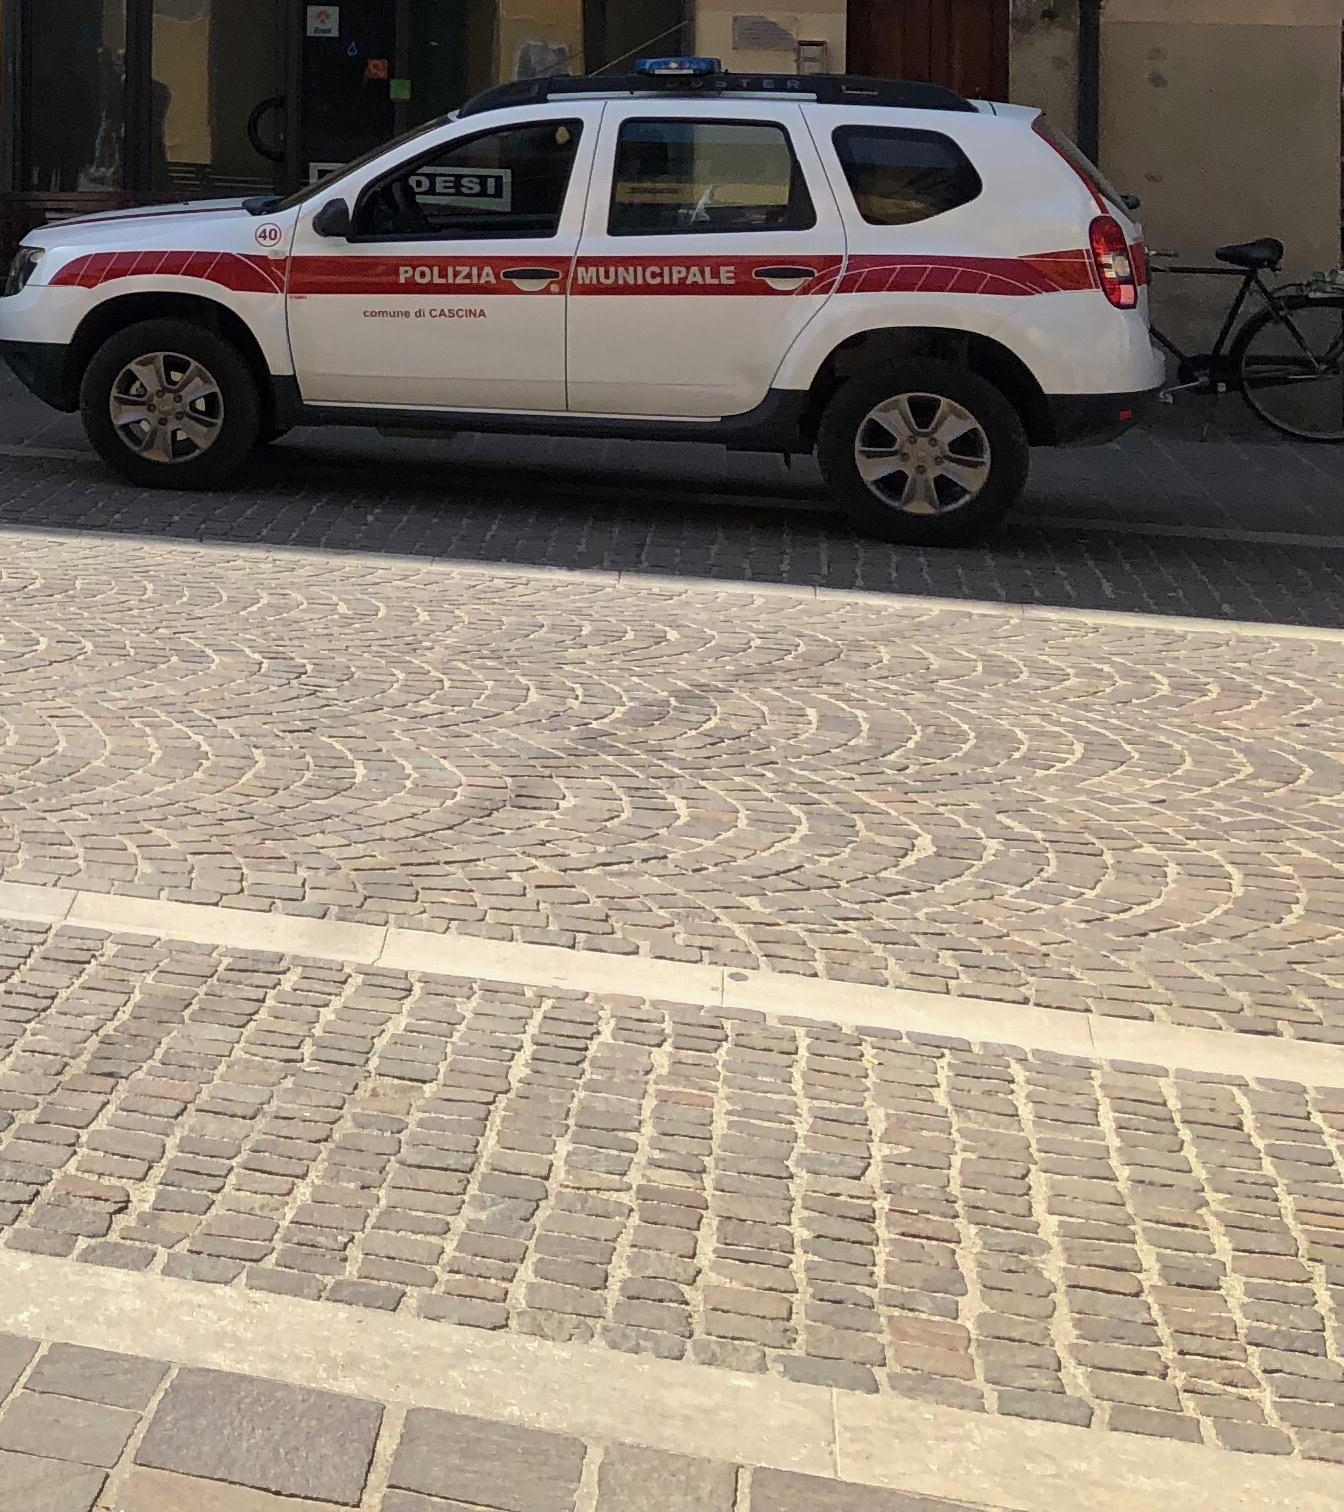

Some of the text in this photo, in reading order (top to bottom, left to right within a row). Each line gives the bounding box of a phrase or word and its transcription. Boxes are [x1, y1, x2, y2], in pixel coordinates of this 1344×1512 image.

[258, 228, 278, 241] 40
[398, 265, 737, 285] POLIZIA MUNICIPALE
[362, 308, 487, 319] comune di CASCINA
